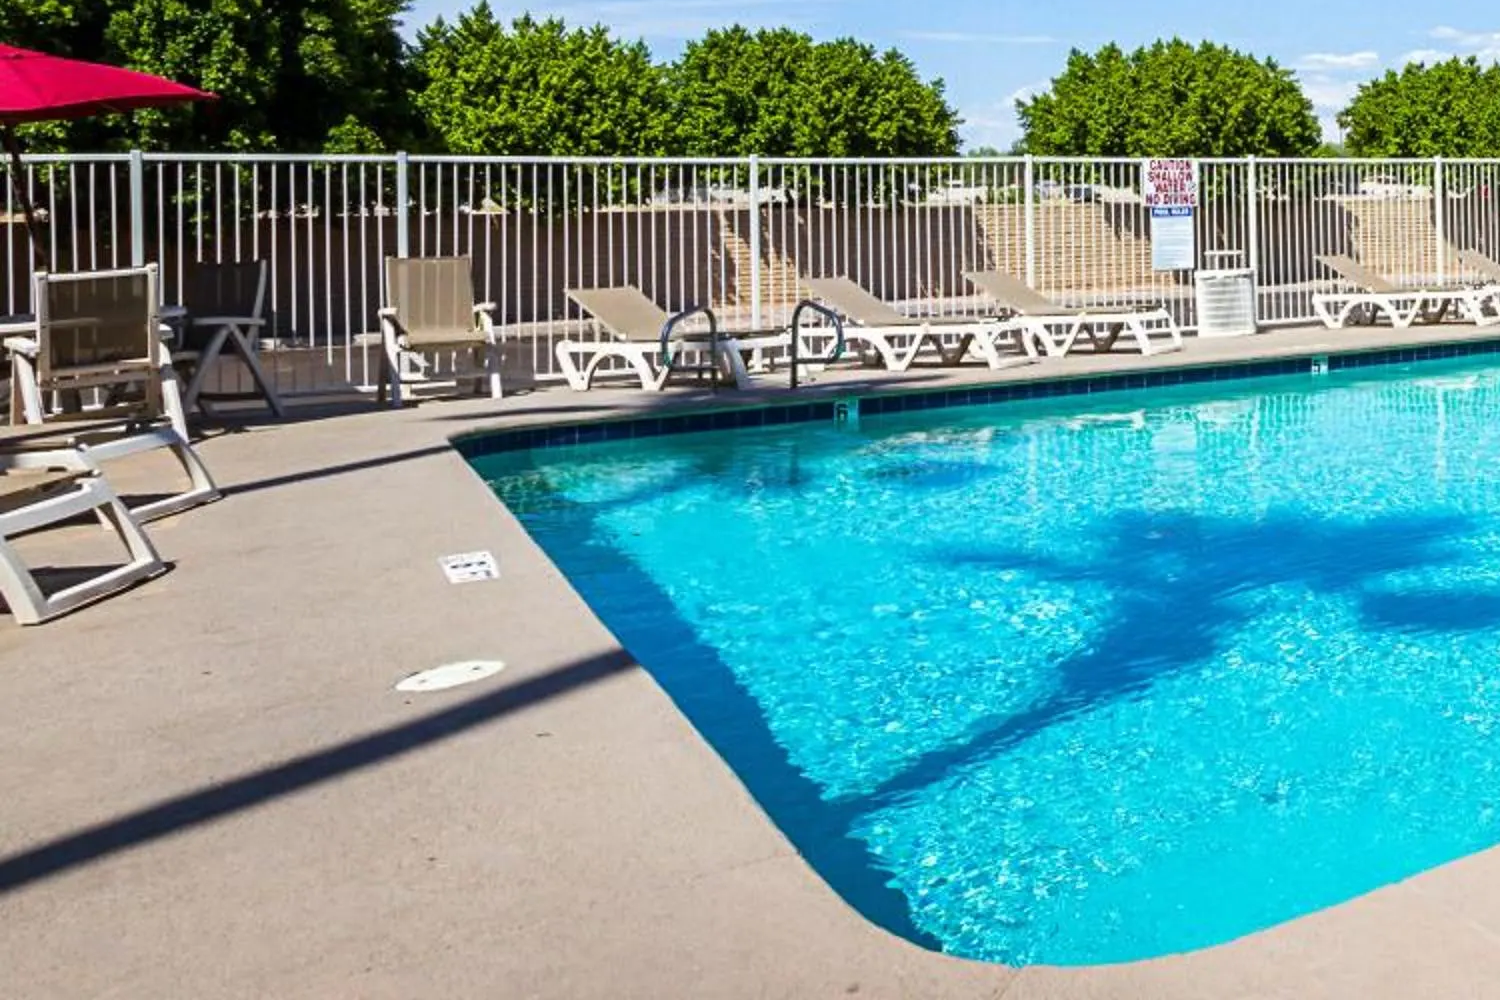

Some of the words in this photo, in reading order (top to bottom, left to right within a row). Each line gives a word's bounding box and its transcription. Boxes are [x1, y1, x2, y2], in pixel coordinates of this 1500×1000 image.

[1150, 160, 1192, 170] CAUTION
[1148, 172, 1193, 182] SHALLOW
[1154, 182, 1186, 192] WATER
[1146, 194, 1160, 204] NO
[1163, 194, 1196, 204] DIVING
